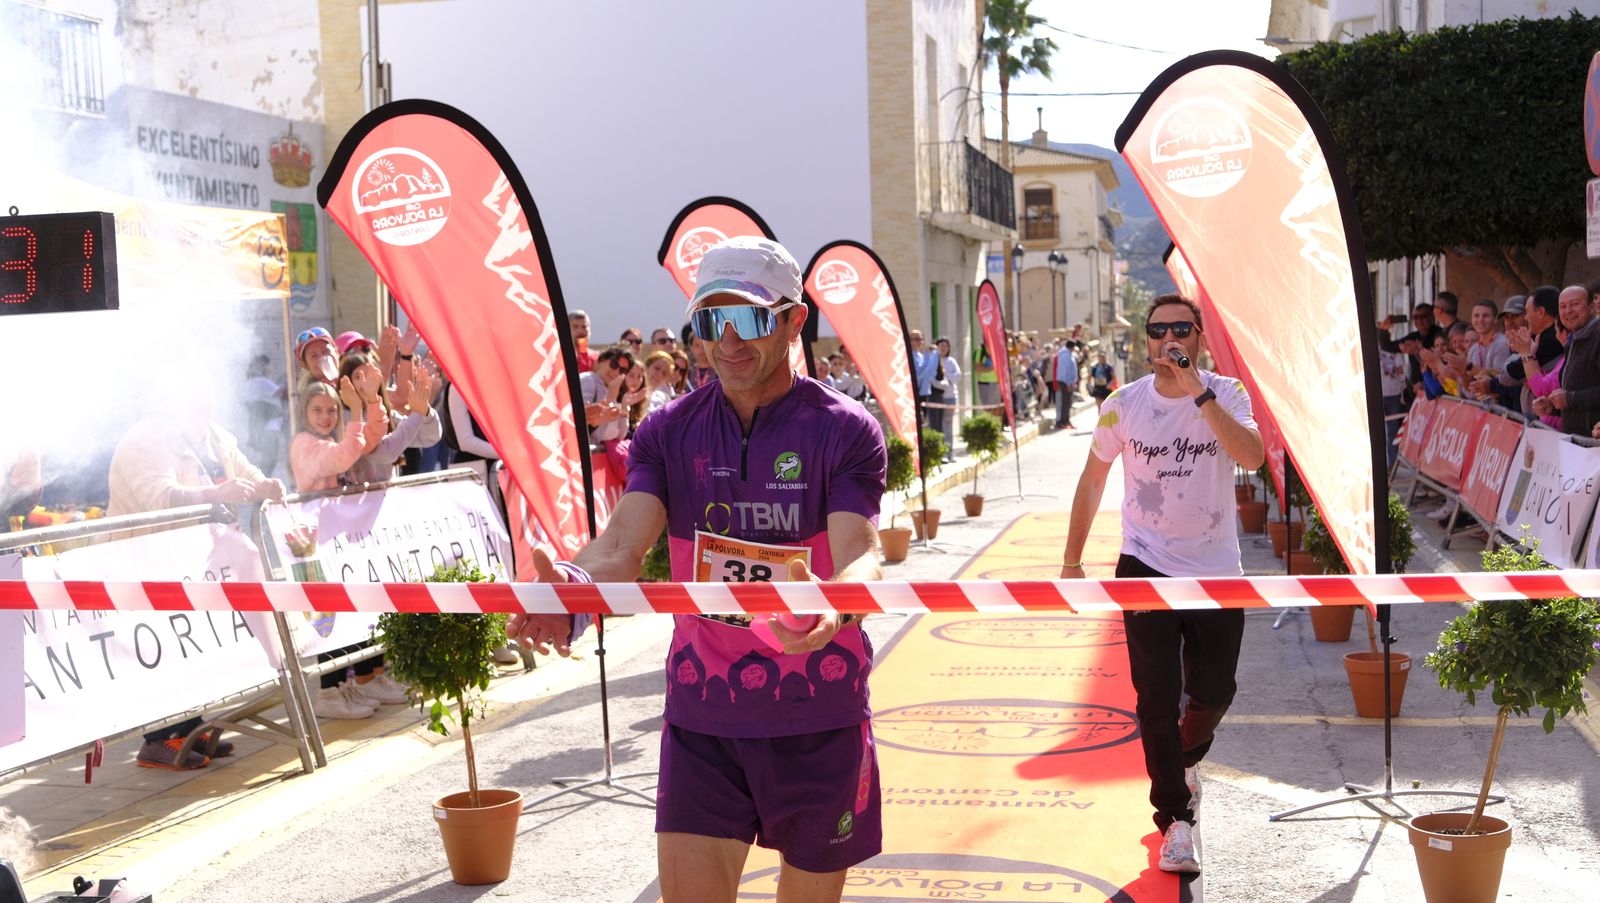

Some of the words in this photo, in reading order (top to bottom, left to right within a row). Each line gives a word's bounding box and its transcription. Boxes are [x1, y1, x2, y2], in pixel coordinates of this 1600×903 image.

[136, 126, 260, 170] EXCELENTÍSIMO
[1129, 438, 1169, 465] Pepe
[1173, 437, 1218, 464] Yepes
[1156, 466, 1194, 480] speaker
[733, 501, 800, 532] TBM
[723, 560, 773, 583] 38
[24, 609, 255, 700] ANTORIA
[881, 786, 1019, 798] Cantori
[1031, 790, 1075, 799] de
[1022, 881, 1083, 893] LA
